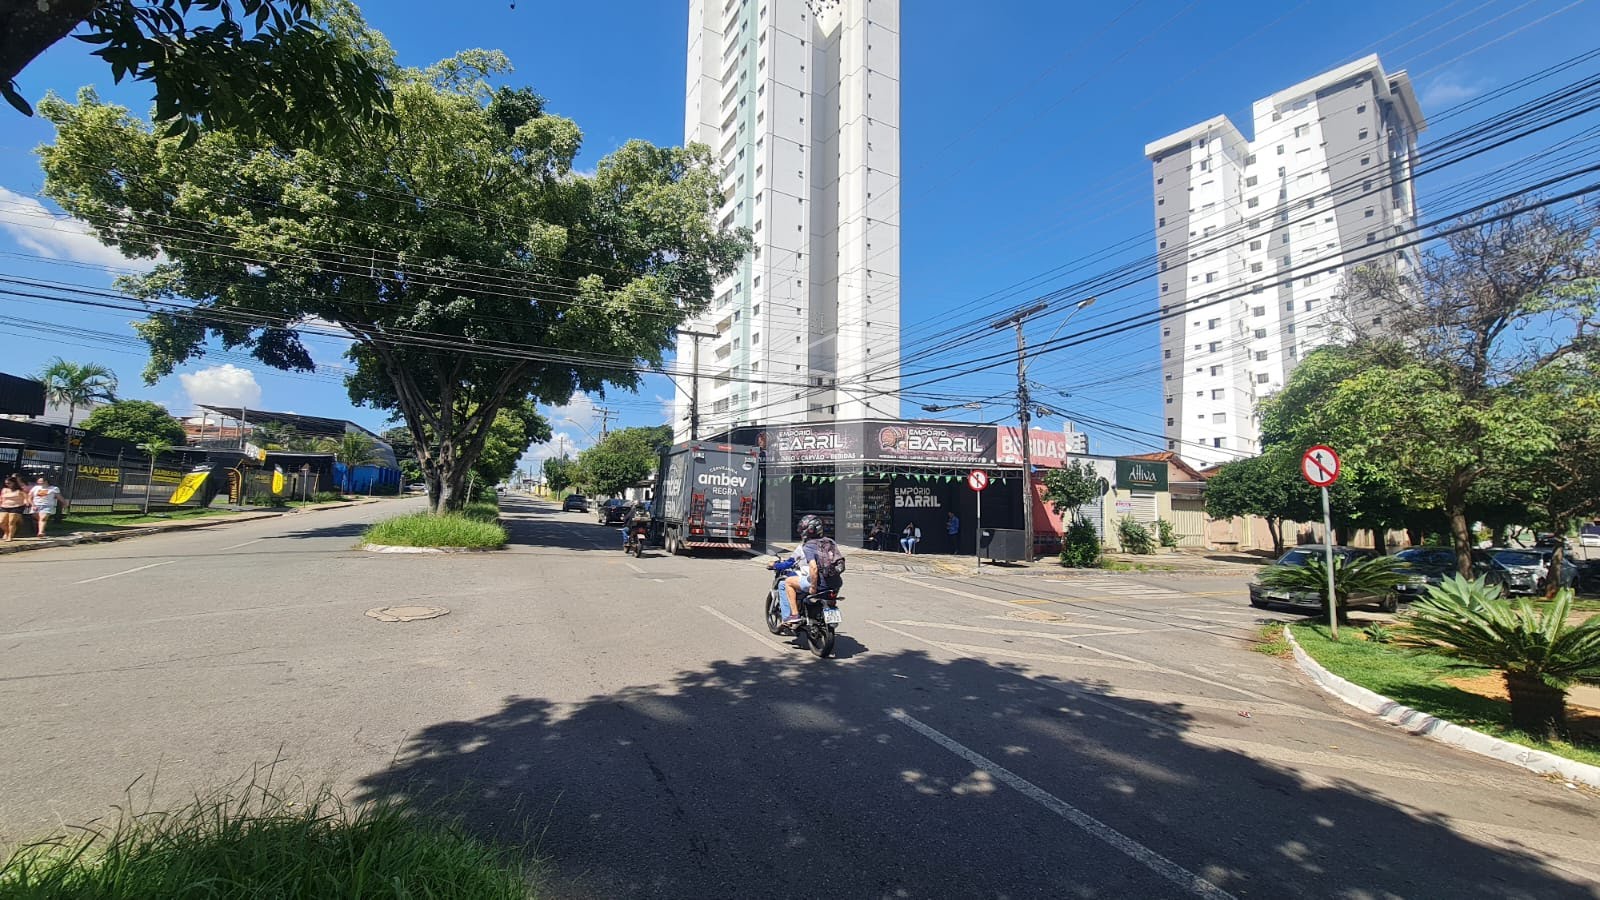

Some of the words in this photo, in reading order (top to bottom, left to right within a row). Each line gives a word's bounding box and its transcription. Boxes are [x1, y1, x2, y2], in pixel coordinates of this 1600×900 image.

[779, 429, 811, 438] EMPÓRIO
[909, 428, 947, 437] EMPÓRIO
[779, 434, 844, 451] BARRIL
[908, 436, 984, 452] BARRIL
[831, 452, 856, 460] BEBIDAS
[79, 465, 99, 474] LAVA
[100, 467, 120, 476] JATO
[698, 472, 747, 488] ambev
[712, 486, 738, 496] REGRA
[894, 486, 931, 495] EMPÓRIO
[894, 495, 941, 508] BARRIL
